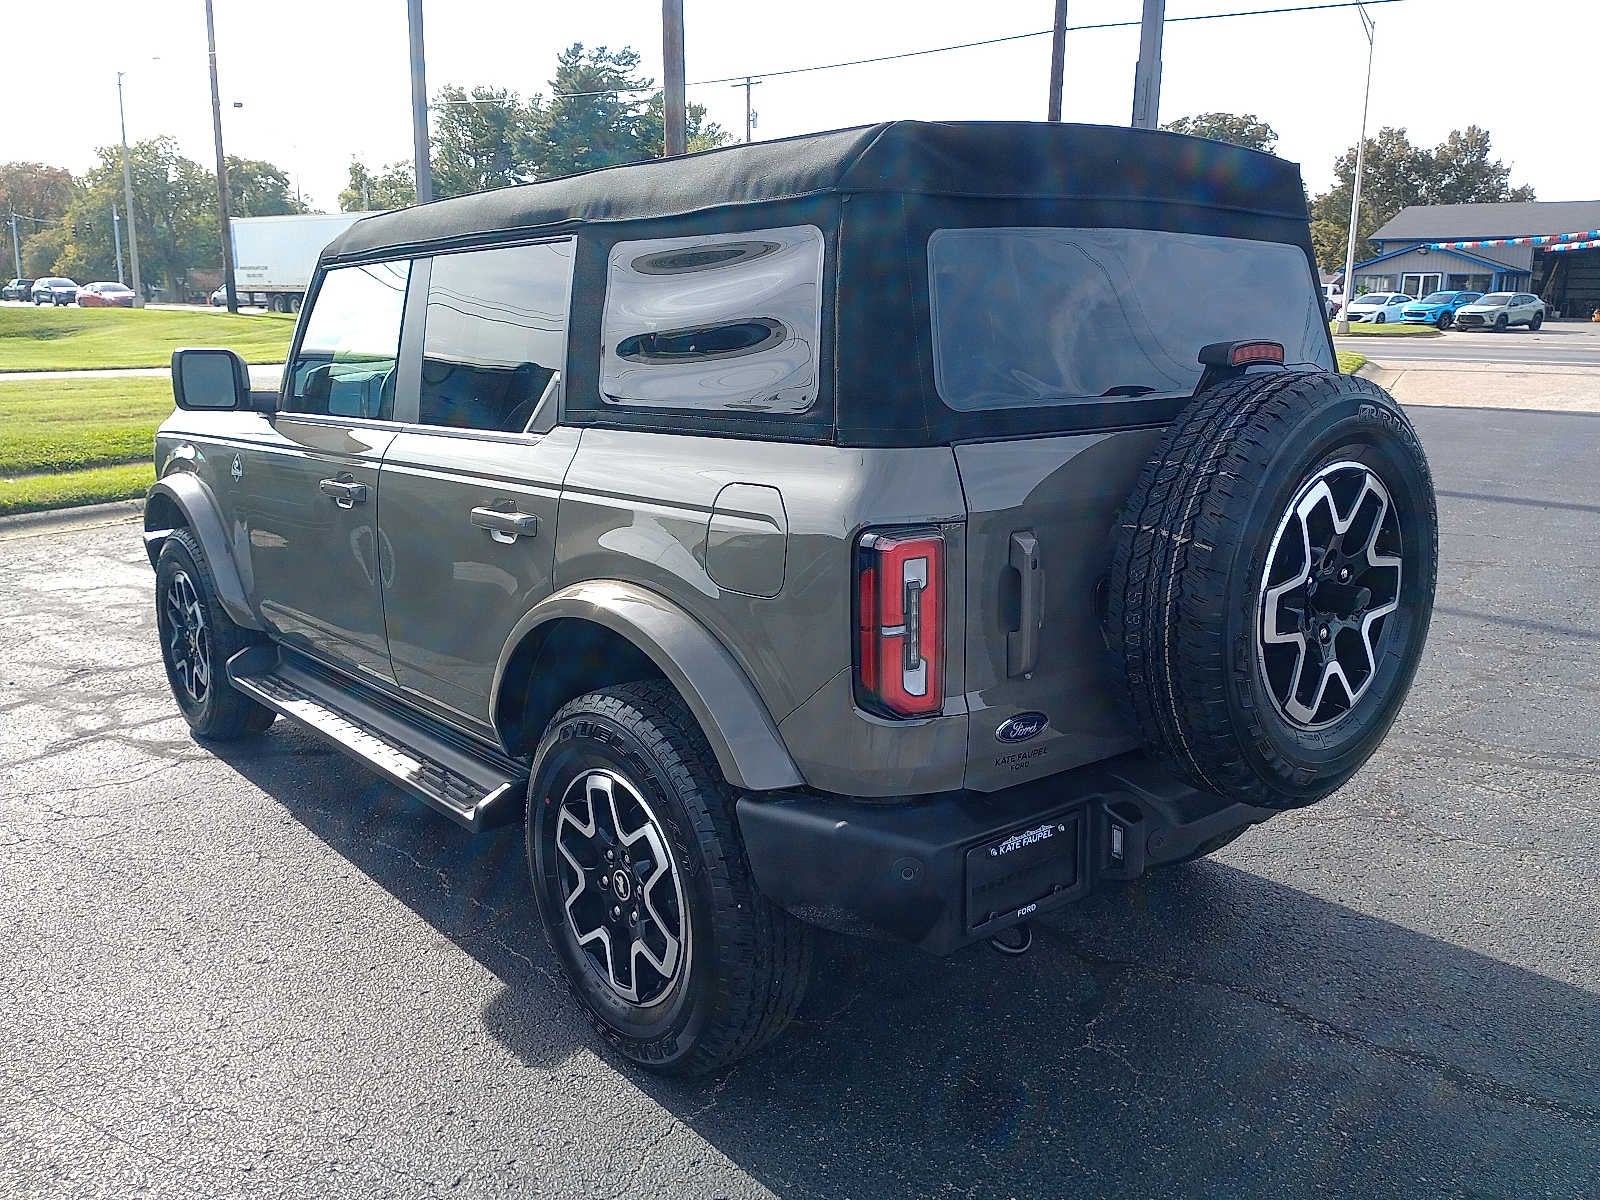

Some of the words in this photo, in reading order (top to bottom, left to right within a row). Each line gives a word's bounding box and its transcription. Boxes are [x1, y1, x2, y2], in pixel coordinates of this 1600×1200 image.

[1010, 721, 1038, 738] Ford
[993, 754, 1016, 767] KATE
[1017, 744, 1048, 761] FAUPEL
[1010, 760, 1030, 771] FORD
[999, 839, 1022, 855] KATE
[1022, 829, 1053, 847] FAUPEL
[1017, 903, 1037, 917] FORD
